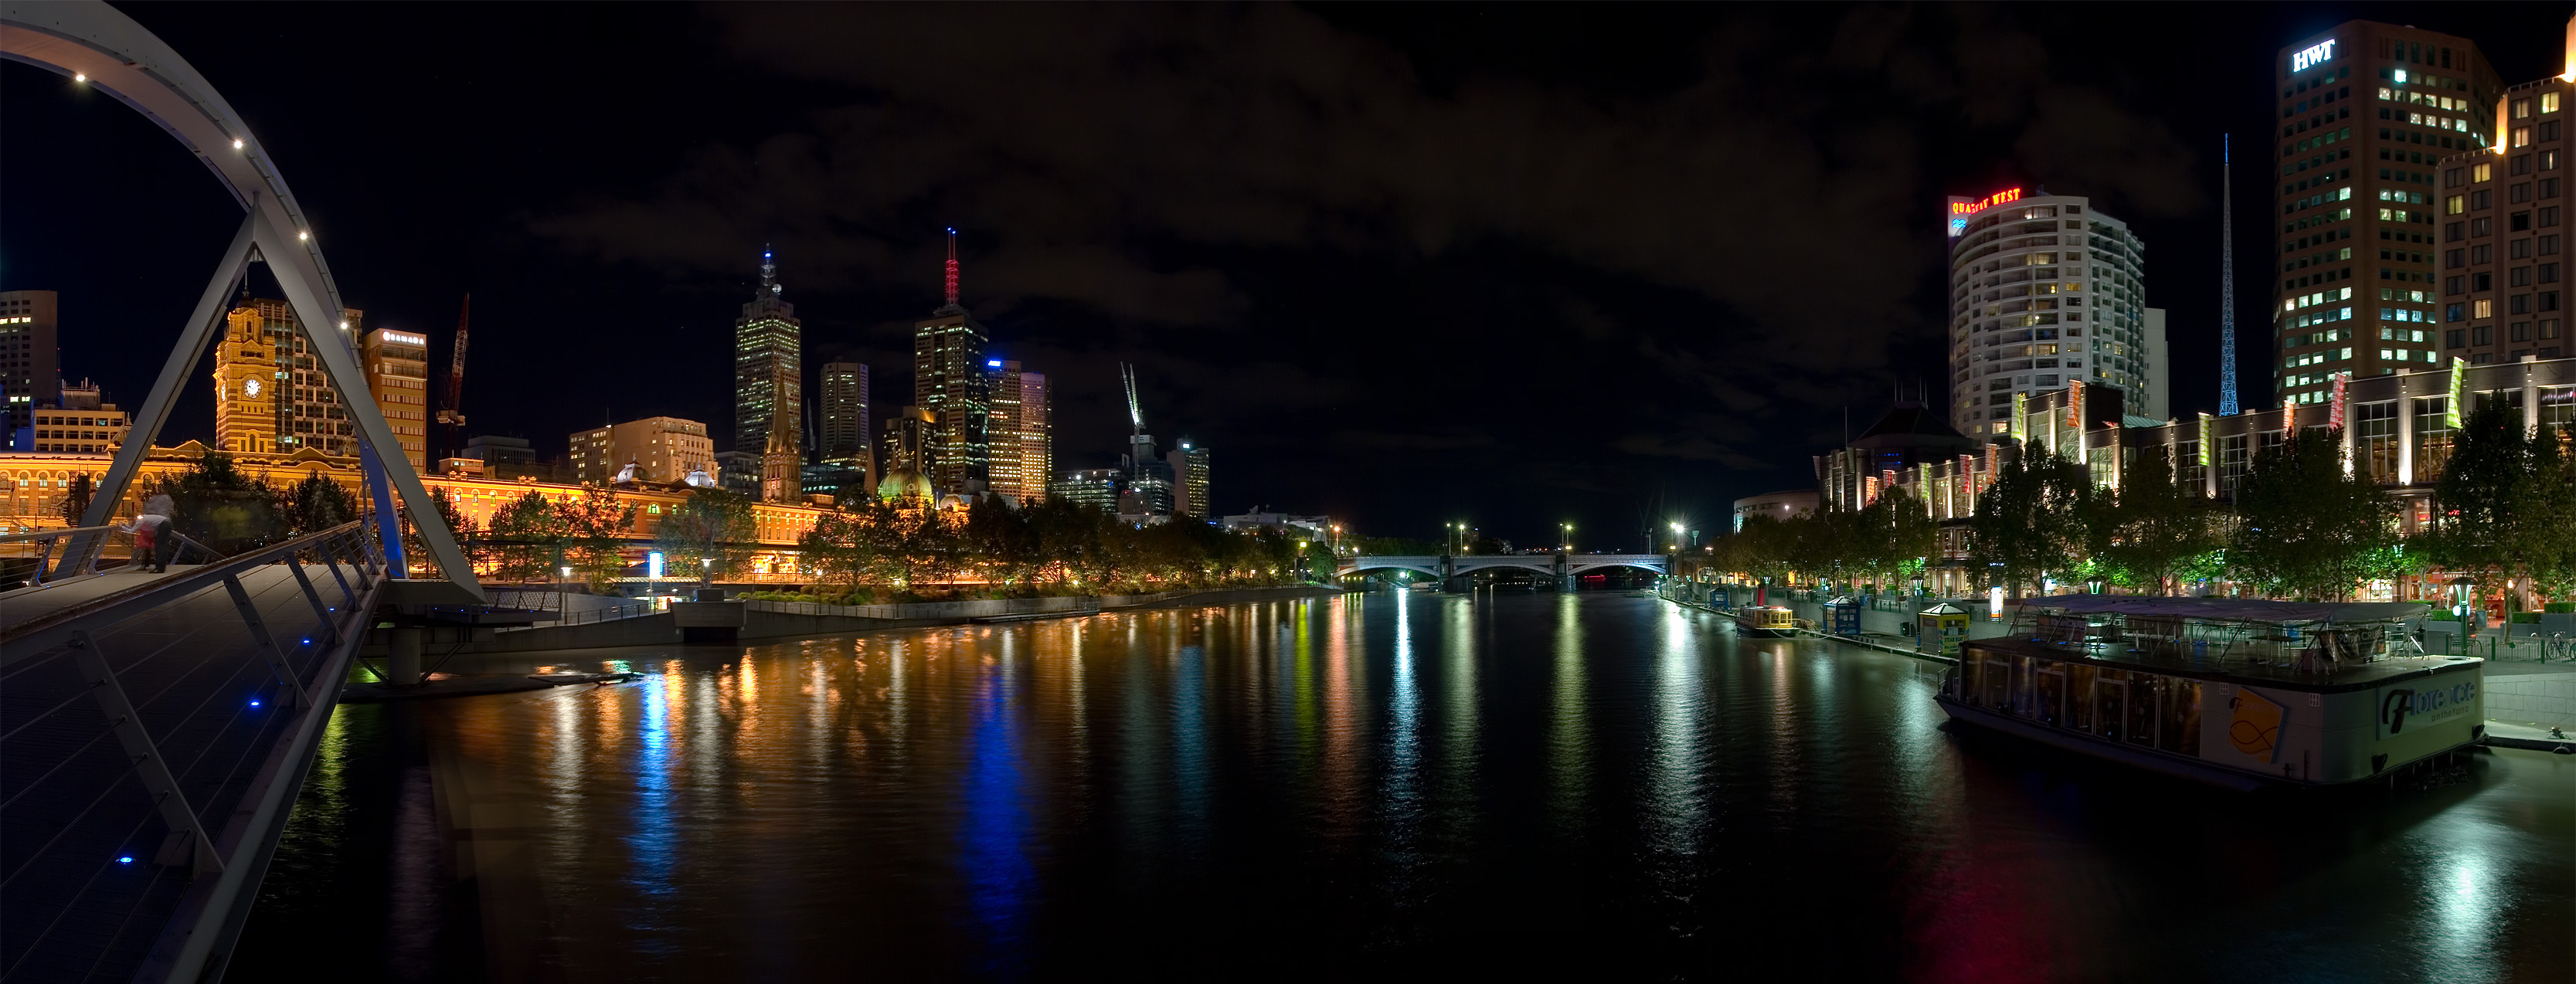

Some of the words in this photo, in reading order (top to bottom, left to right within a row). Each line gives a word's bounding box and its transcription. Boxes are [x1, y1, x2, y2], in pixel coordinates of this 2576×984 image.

[2292, 39, 2336, 73] HWT
[1993, 188, 2020, 205] WEST
[390, 334, 424, 345] RAMADA
